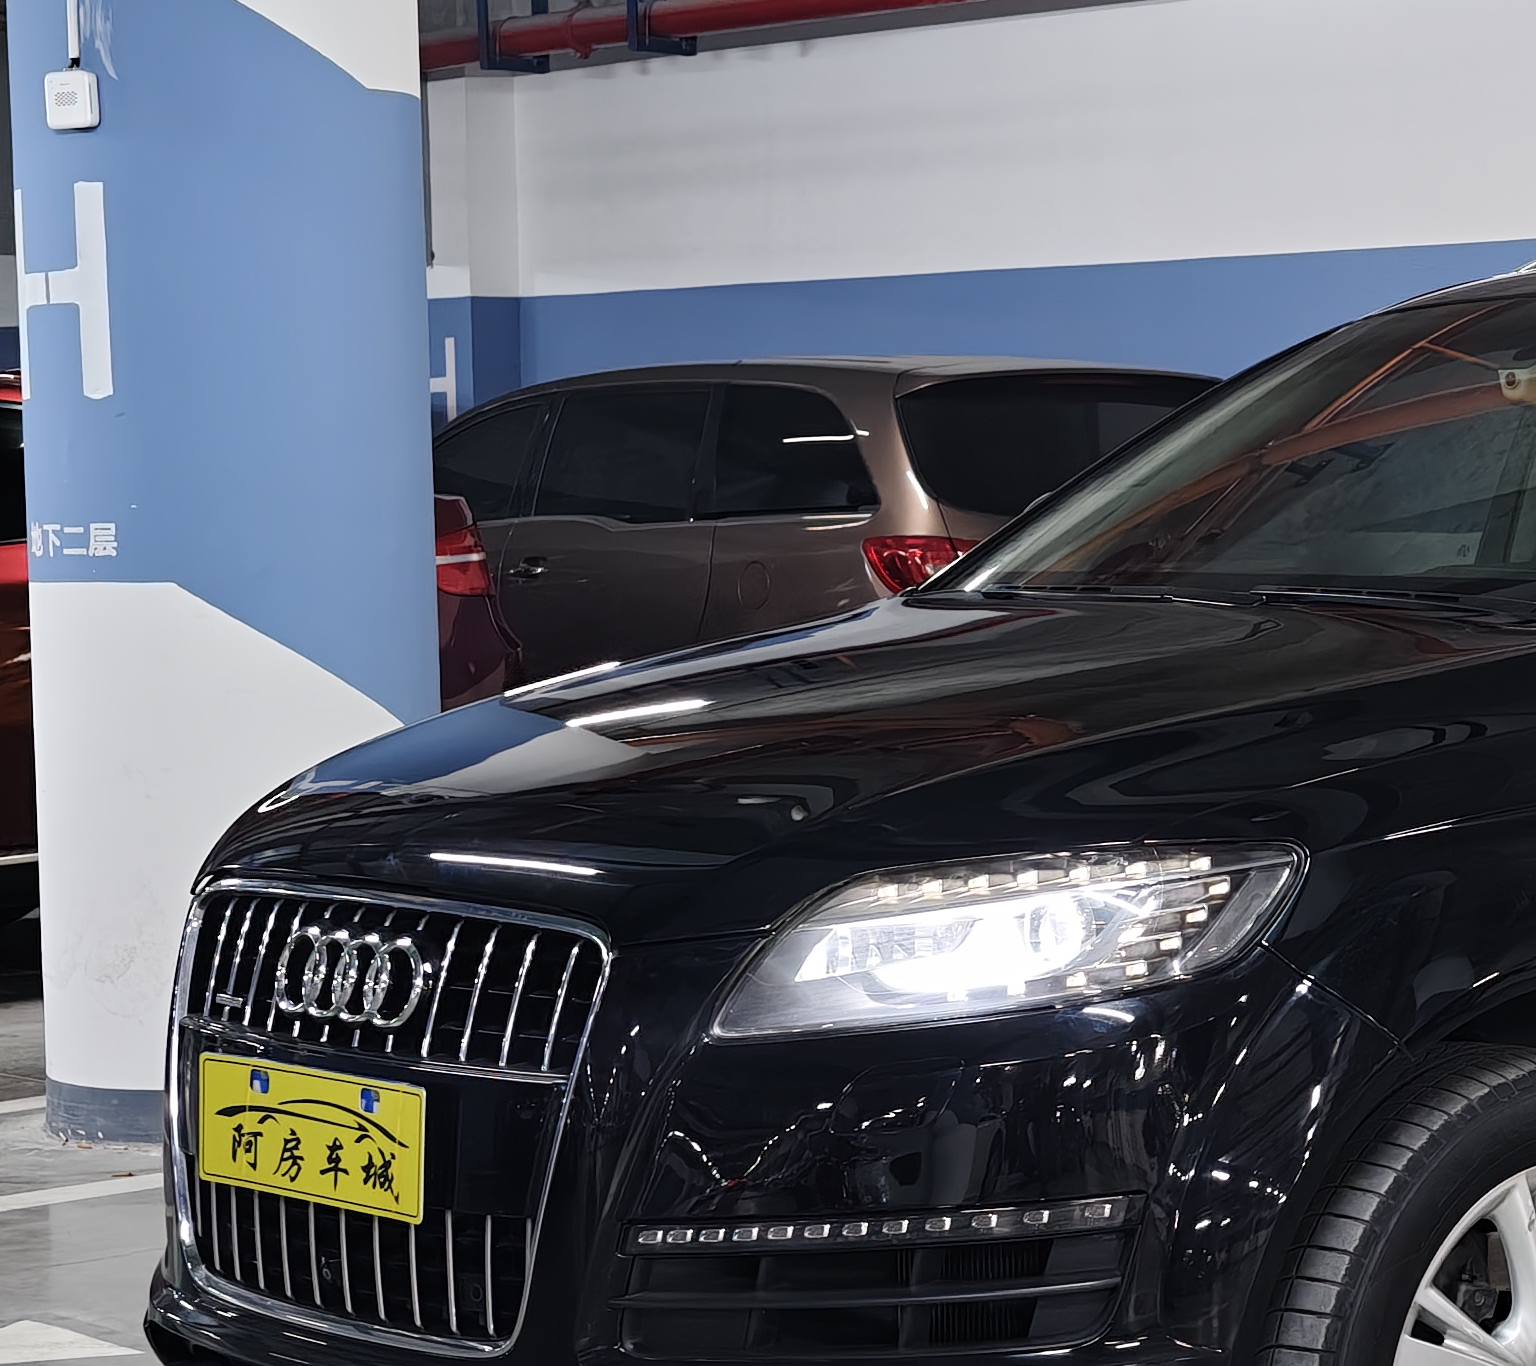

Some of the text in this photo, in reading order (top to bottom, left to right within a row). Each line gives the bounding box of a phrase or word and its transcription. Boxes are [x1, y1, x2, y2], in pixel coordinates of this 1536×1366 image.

[13, 180, 114, 401] H
[30, 521, 119, 558] 地下二层
[231, 1122, 400, 1206] 阿房车城
